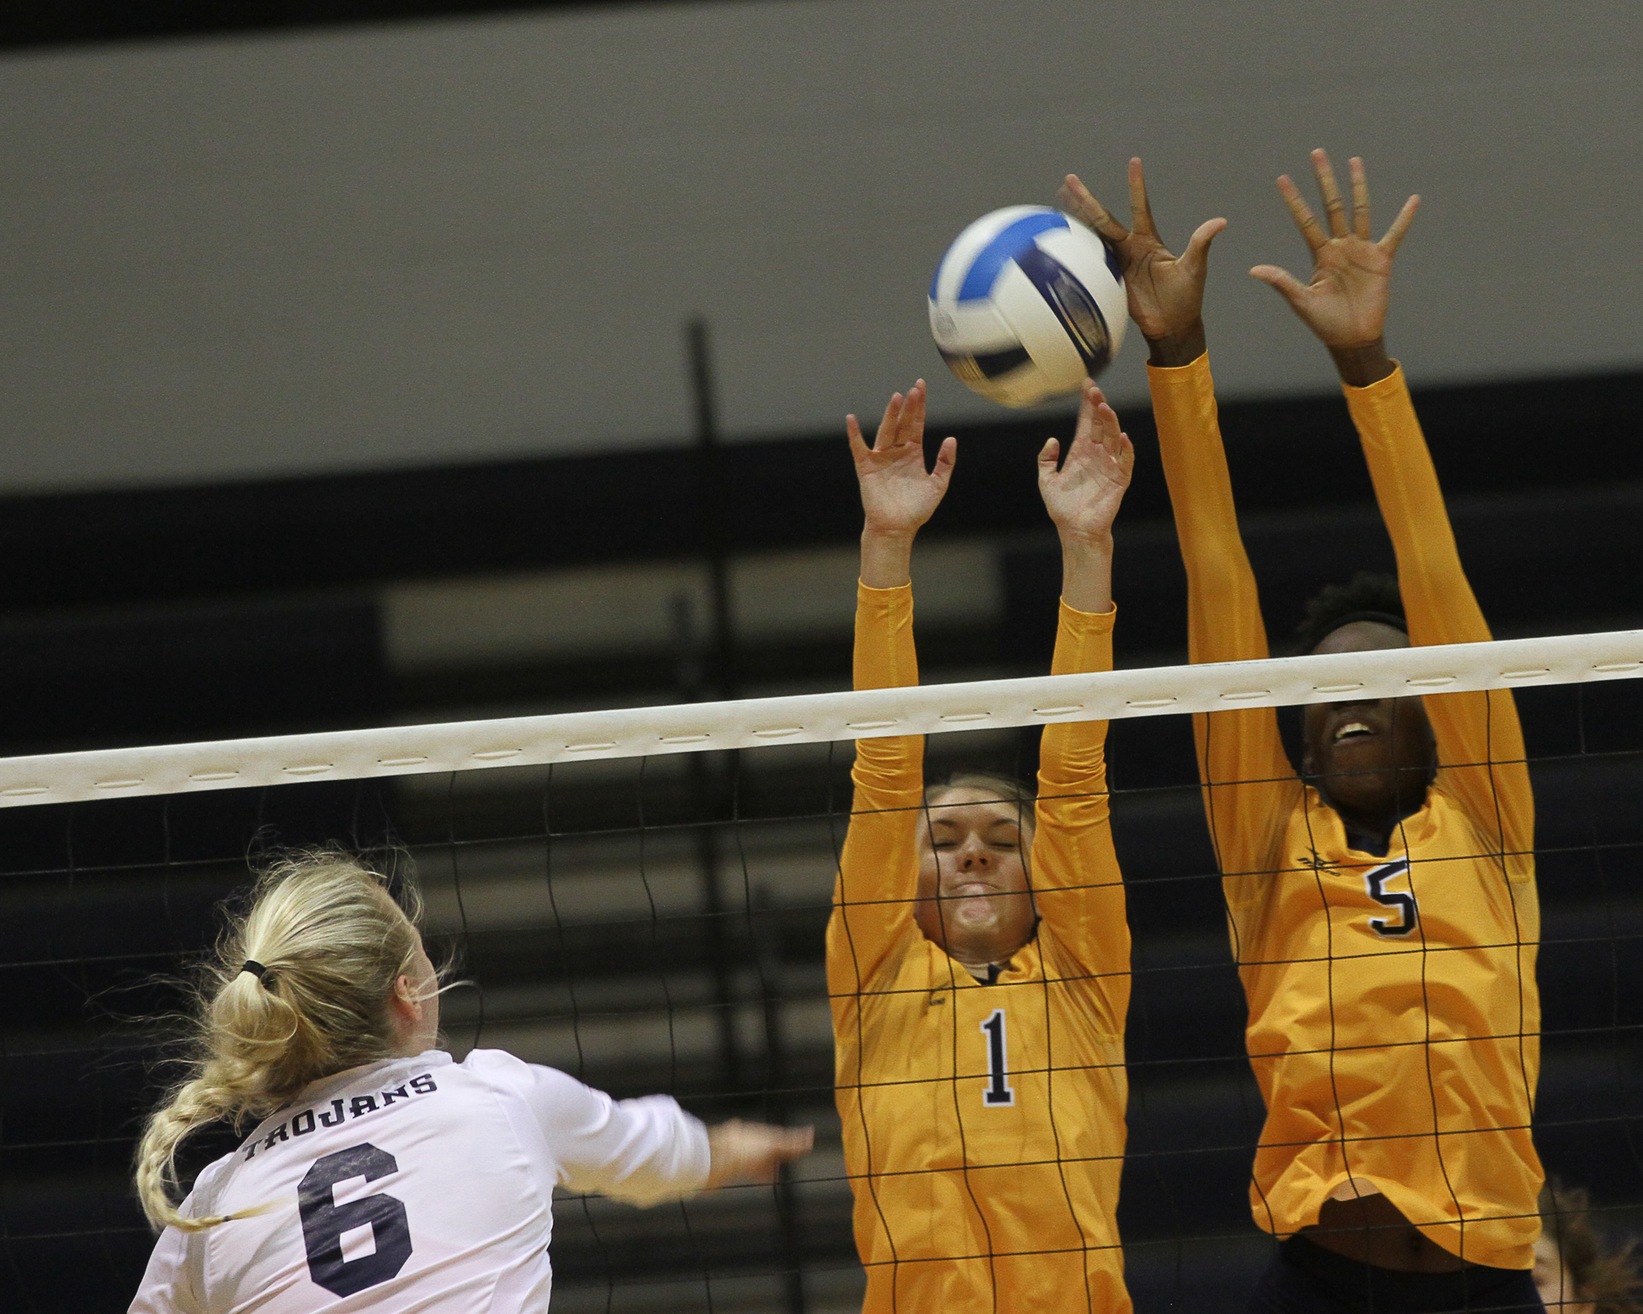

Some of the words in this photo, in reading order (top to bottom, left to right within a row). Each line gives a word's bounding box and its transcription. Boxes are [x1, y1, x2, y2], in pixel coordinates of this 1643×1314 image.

[1364, 856, 1416, 937] 5
[980, 1009, 1015, 1107] 1
[243, 1073, 438, 1161] TROJANS
[297, 1142, 413, 1298] 6
